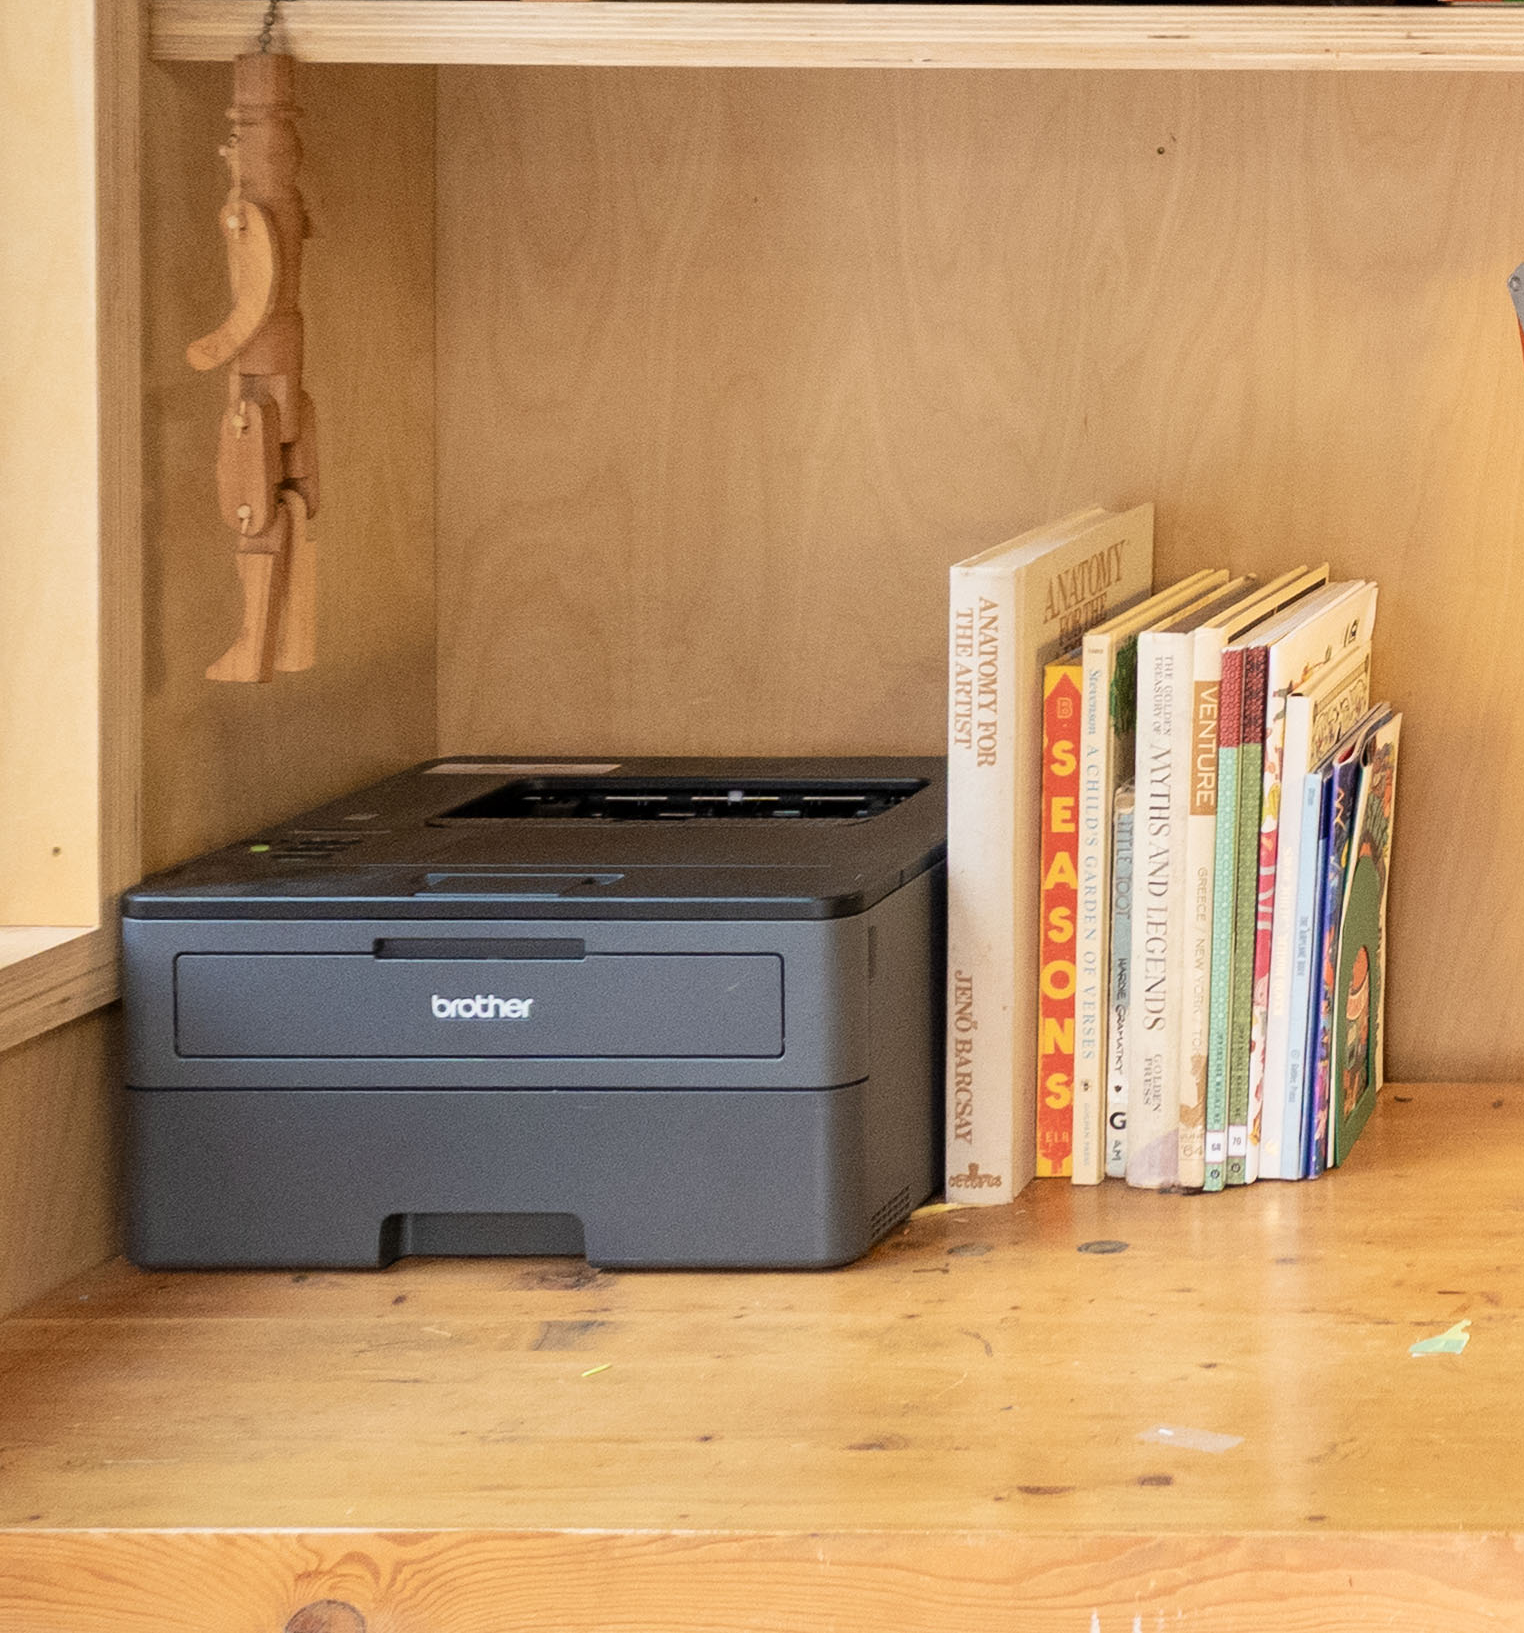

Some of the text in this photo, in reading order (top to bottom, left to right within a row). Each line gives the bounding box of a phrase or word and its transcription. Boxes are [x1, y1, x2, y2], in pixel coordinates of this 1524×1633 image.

[1043, 538, 1127, 623] ANATOMY
[953, 608, 974, 750] THE ARTIST
[976, 595, 1001, 769] ANATOMY FOR
[1194, 684, 1217, 808] VENTURE
[1084, 764, 1100, 846] CHILD'S
[1042, 739, 1078, 1111] SEASONS
[1083, 856, 1098, 940] GARDEN
[1142, 744, 1172, 1031] MYTHS AND LEGENDS
[430, 993, 535, 1019] brother
[1083, 951, 1097, 977] OF
[952, 970, 974, 1146] JENŐ BARCSAY
[1082, 986, 1097, 1060] VERSES
